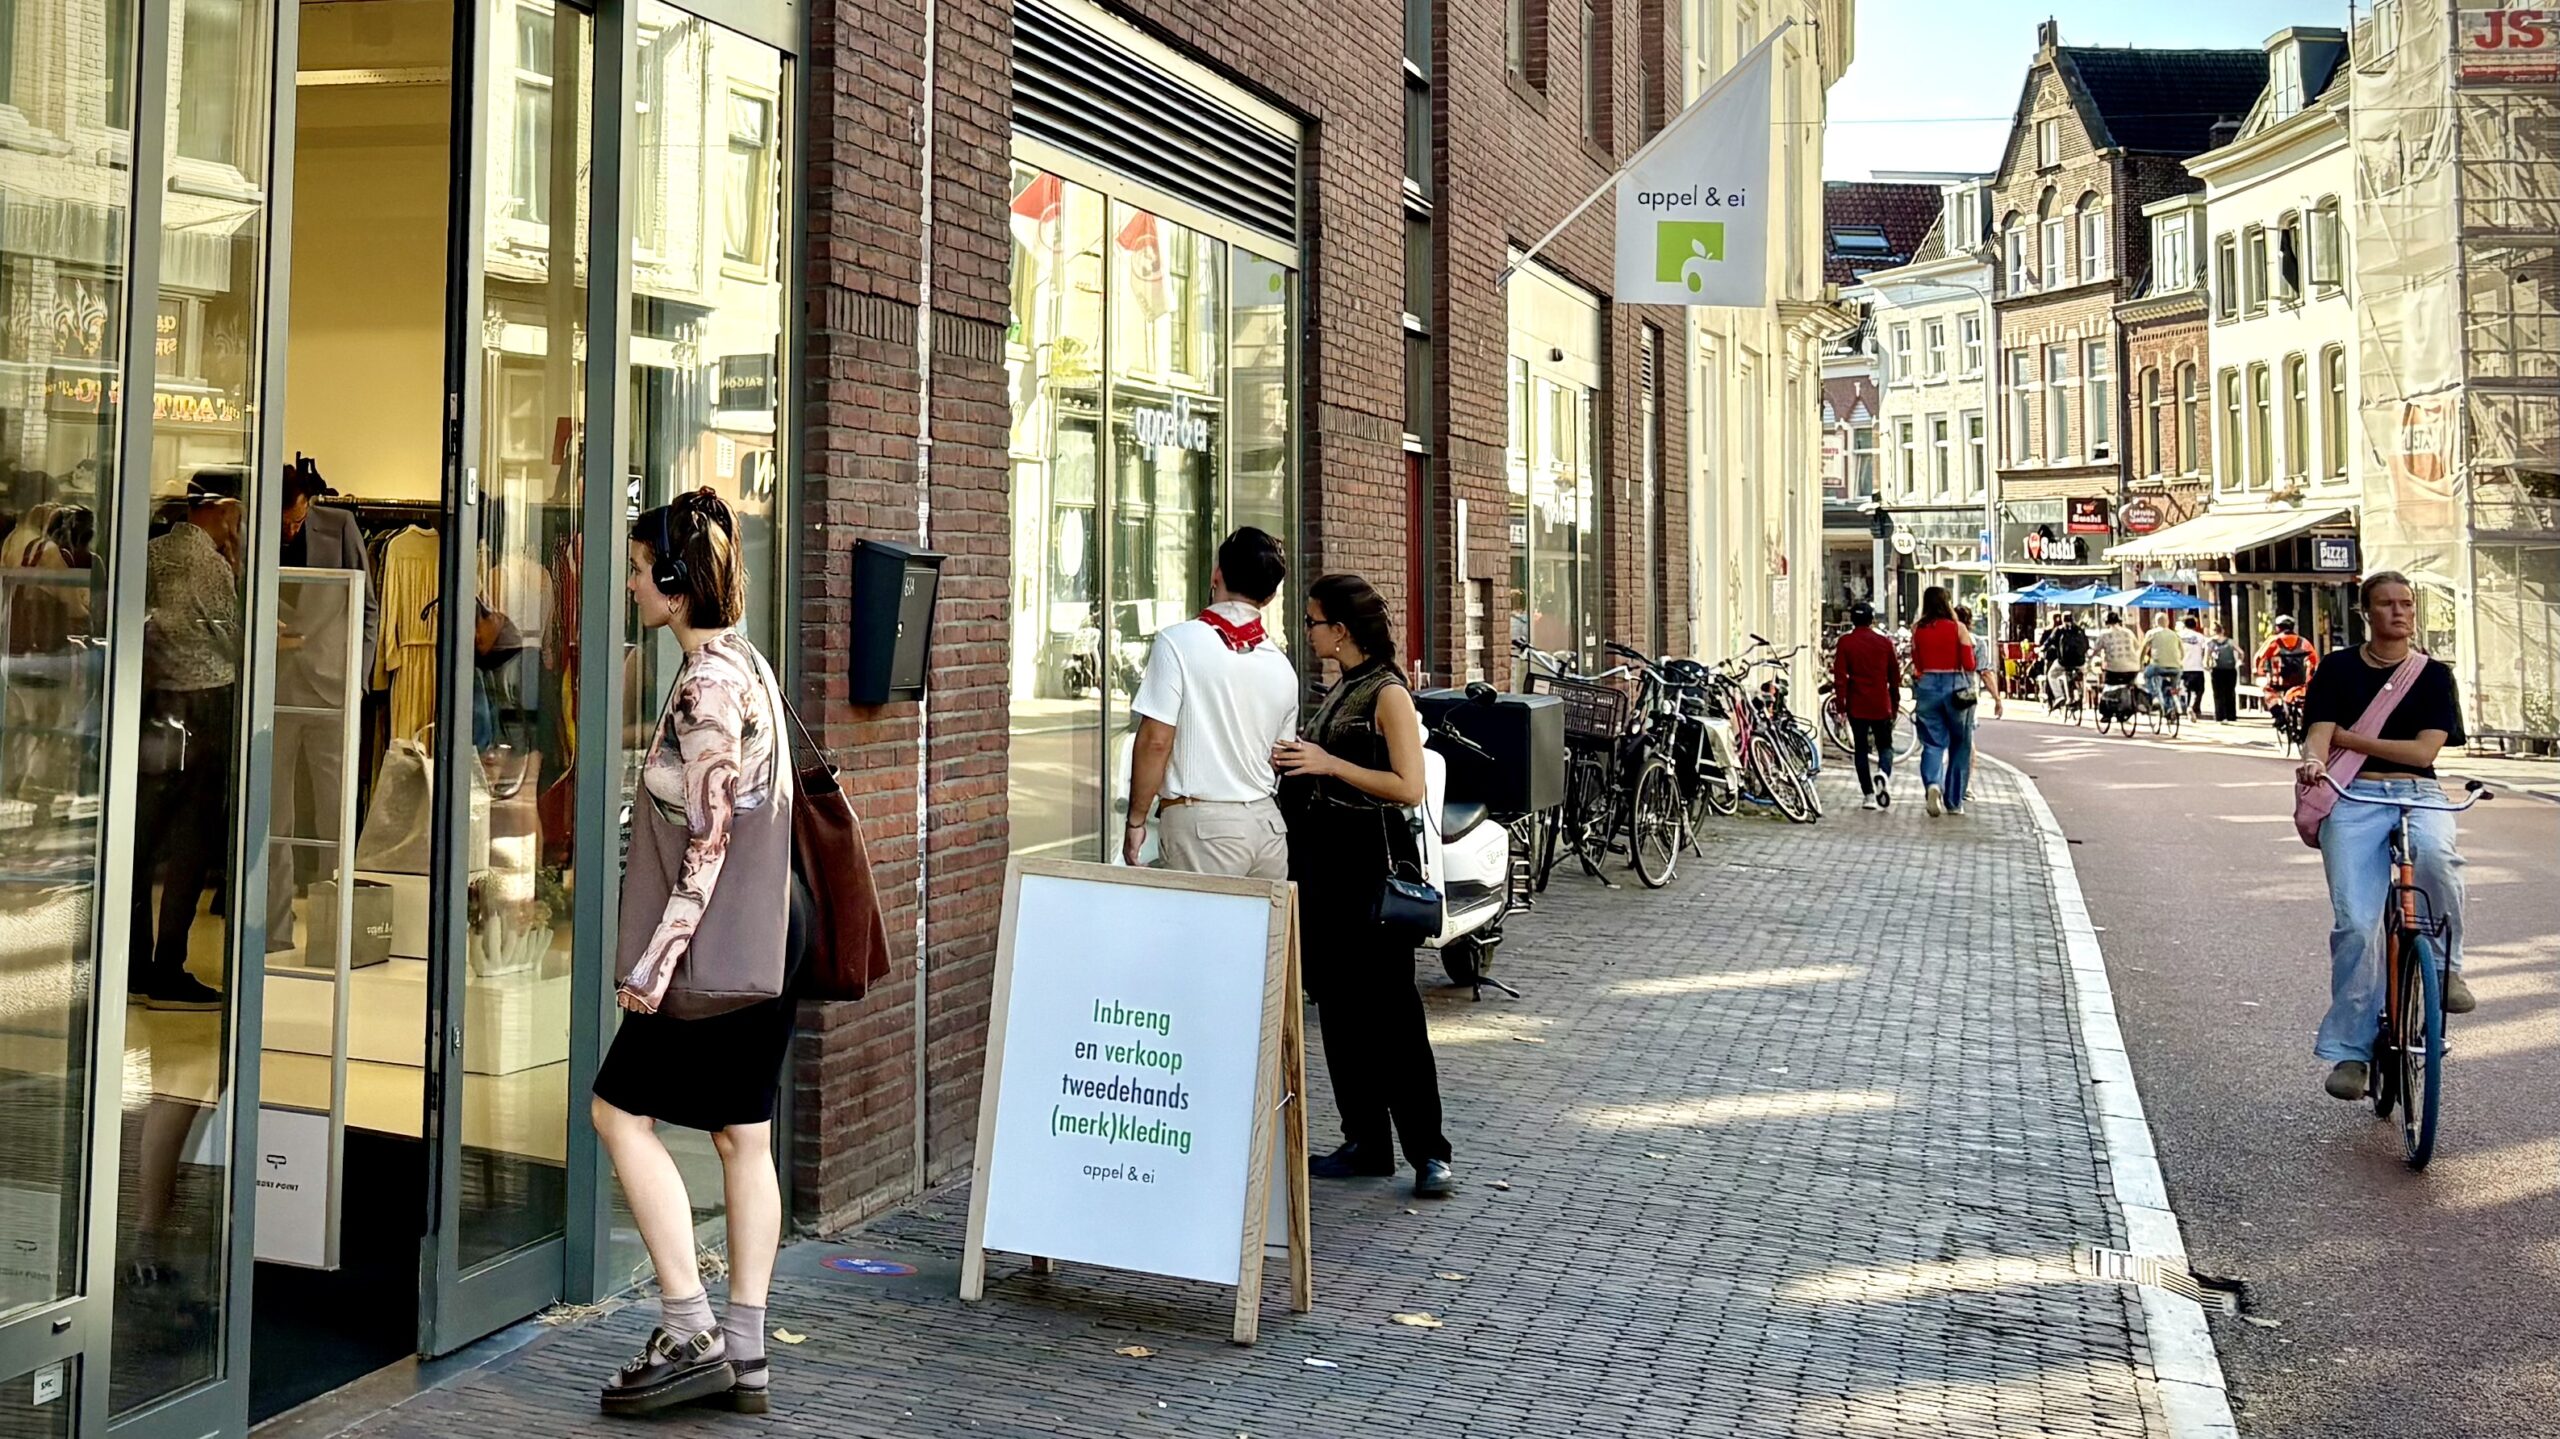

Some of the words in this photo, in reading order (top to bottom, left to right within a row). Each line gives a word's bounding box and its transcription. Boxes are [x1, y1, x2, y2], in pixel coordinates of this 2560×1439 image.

[2473, 10, 2545, 49] JS
[1638, 184, 1698, 211] appel
[1705, 187, 1721, 207] &
[1727, 188, 1745, 207] ei
[2040, 535, 2077, 560] Sushi
[1093, 998, 1170, 1036] Inbreng
[1075, 1041, 1097, 1060] en
[1105, 1040, 1183, 1075] verkoop
[1062, 1073, 1189, 1110] tweedehands
[1051, 1104, 1192, 1154] (merk)kleding
[1083, 1163, 1124, 1181] appel
[1128, 1166, 1138, 1181] &
[1142, 1169, 1155, 1183] ei
